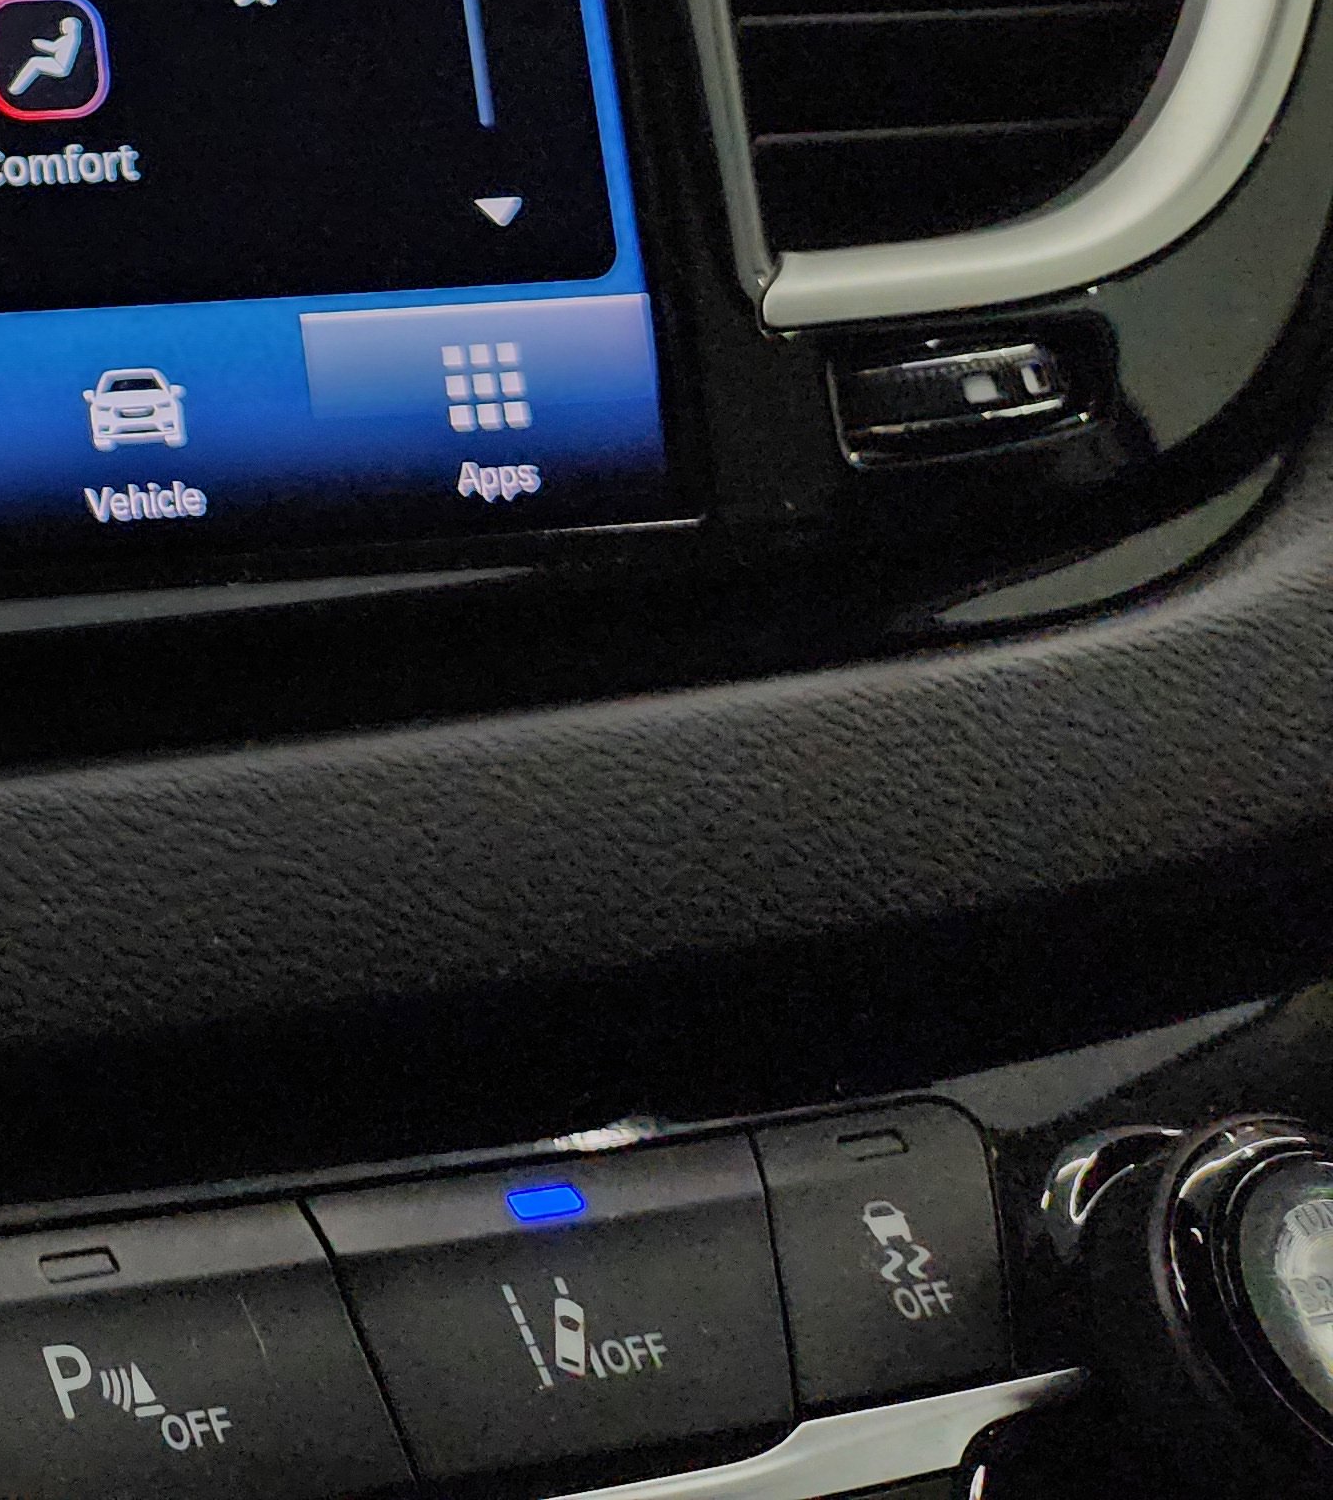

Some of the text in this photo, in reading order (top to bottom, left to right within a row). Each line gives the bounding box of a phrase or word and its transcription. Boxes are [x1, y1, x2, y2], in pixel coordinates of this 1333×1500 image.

[81, 479, 209, 524] Vehicle
[456, 460, 542, 504] Apps
[893, 1280, 954, 1321] OFF
[601, 1332, 669, 1376] OFF
[41, 1343, 93, 1420] P
[160, 1405, 233, 1451] OFF
